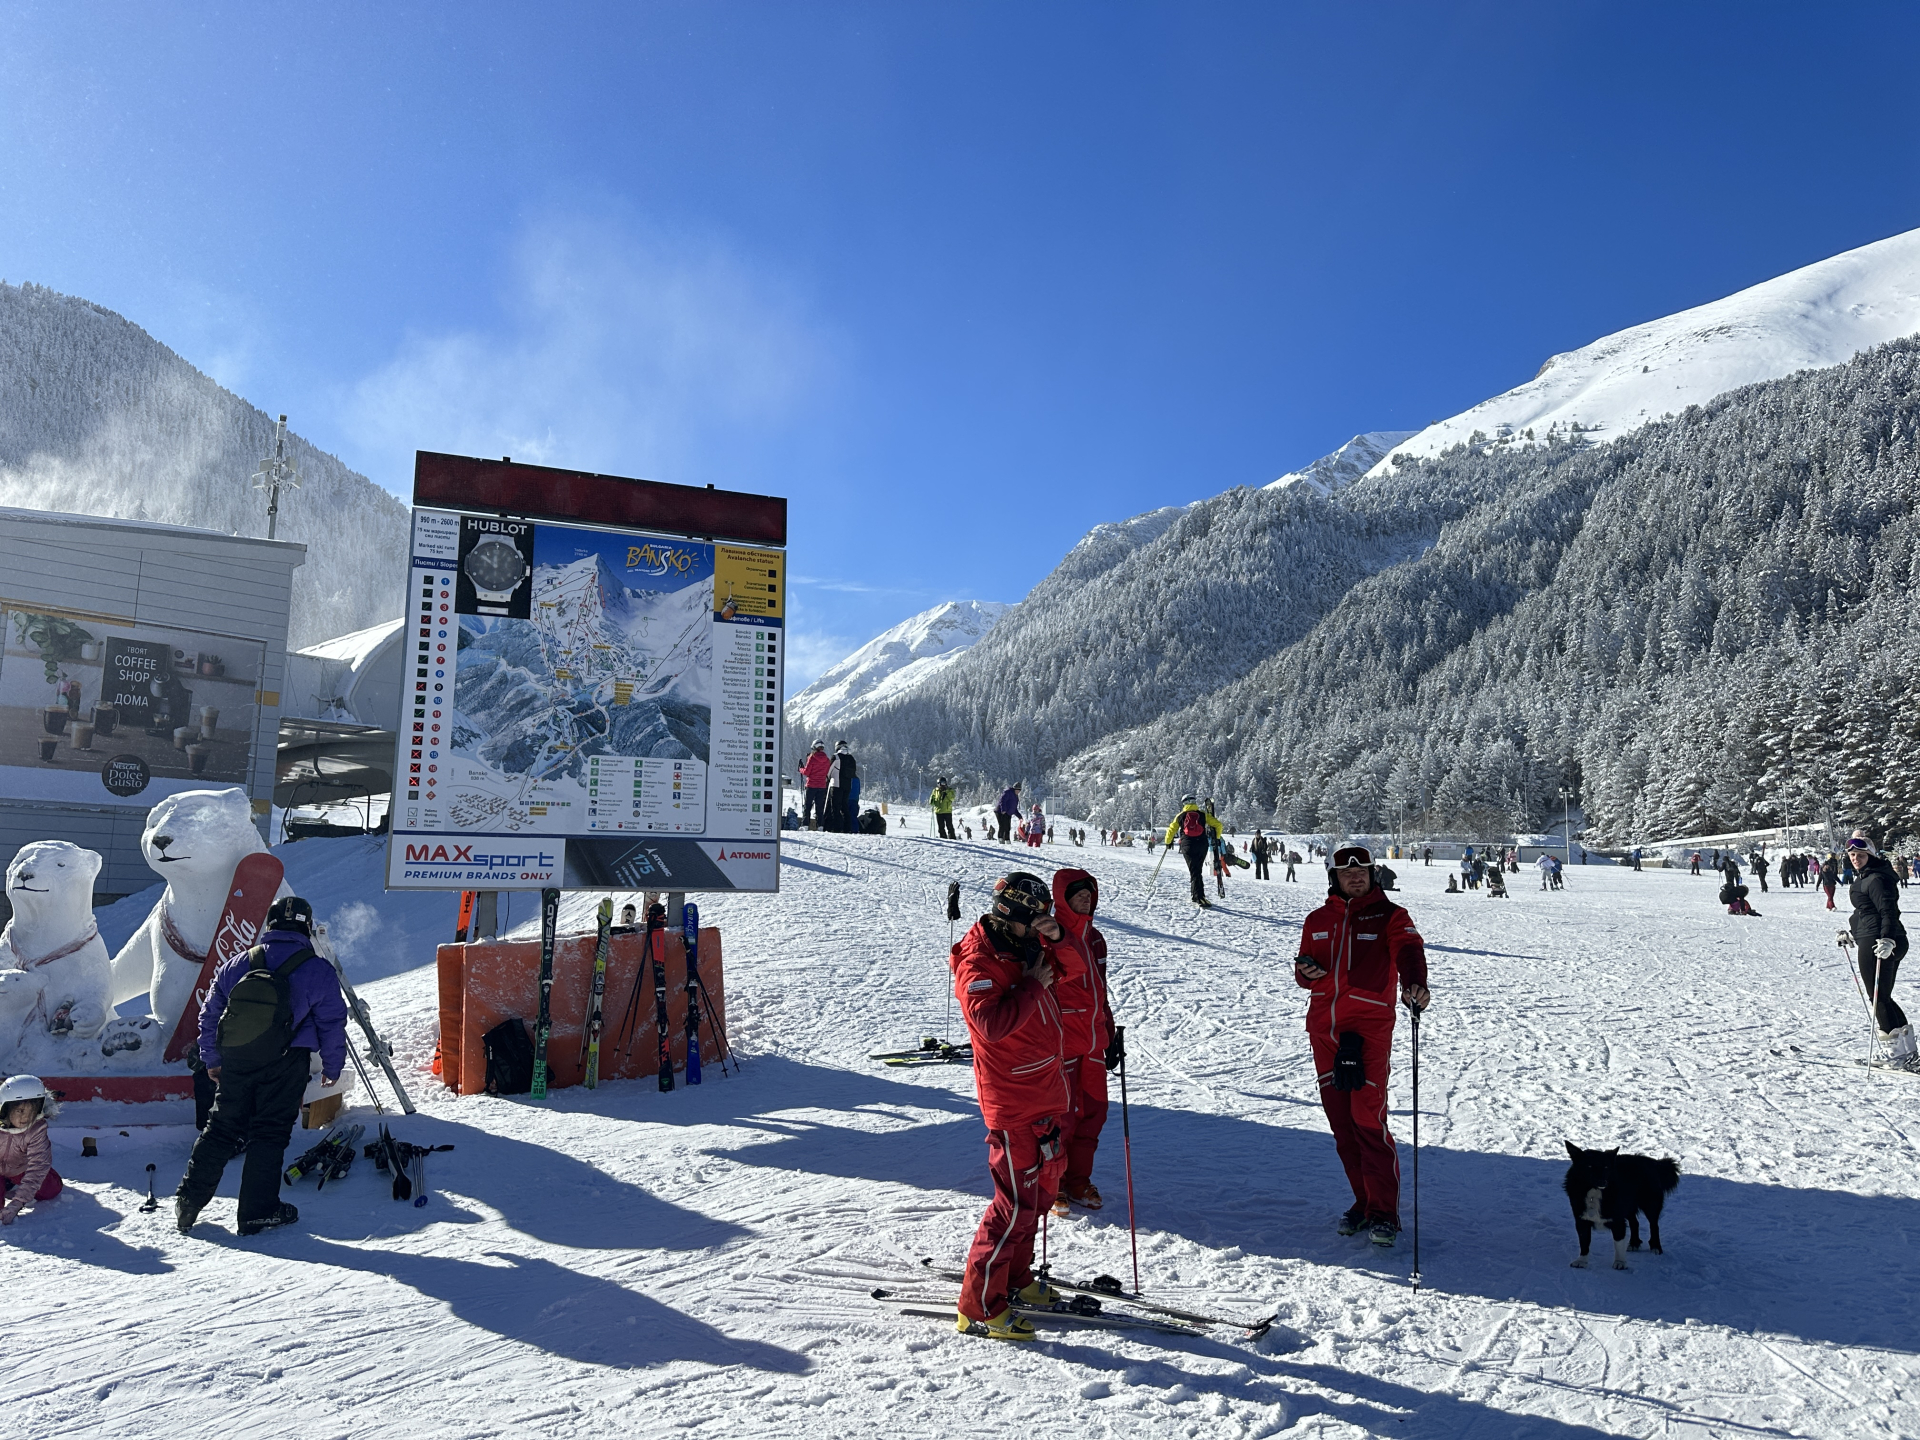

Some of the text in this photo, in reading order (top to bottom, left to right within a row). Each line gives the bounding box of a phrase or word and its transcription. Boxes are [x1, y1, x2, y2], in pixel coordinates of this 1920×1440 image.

[441, 518, 453, 526] 2600
[468, 520, 527, 535] HUBLOT
[626, 544, 692, 576] BANSKO
[747, 551, 780, 559] обстановка
[127, 646, 148, 654] ТВОЯТ
[115, 655, 157, 670] COFFEE
[119, 669, 150, 682] SHOP
[114, 693, 148, 707] ДОМА
[109, 769, 143, 780] Dolce
[109, 777, 142, 787] Gusto
[405, 844, 554, 870] MAXsport
[632, 854, 655, 874] 175
[651, 854, 672, 877] ATOMIC
[404, 871, 462, 879] PREMIUM
[545, 904, 554, 950] HEAD
